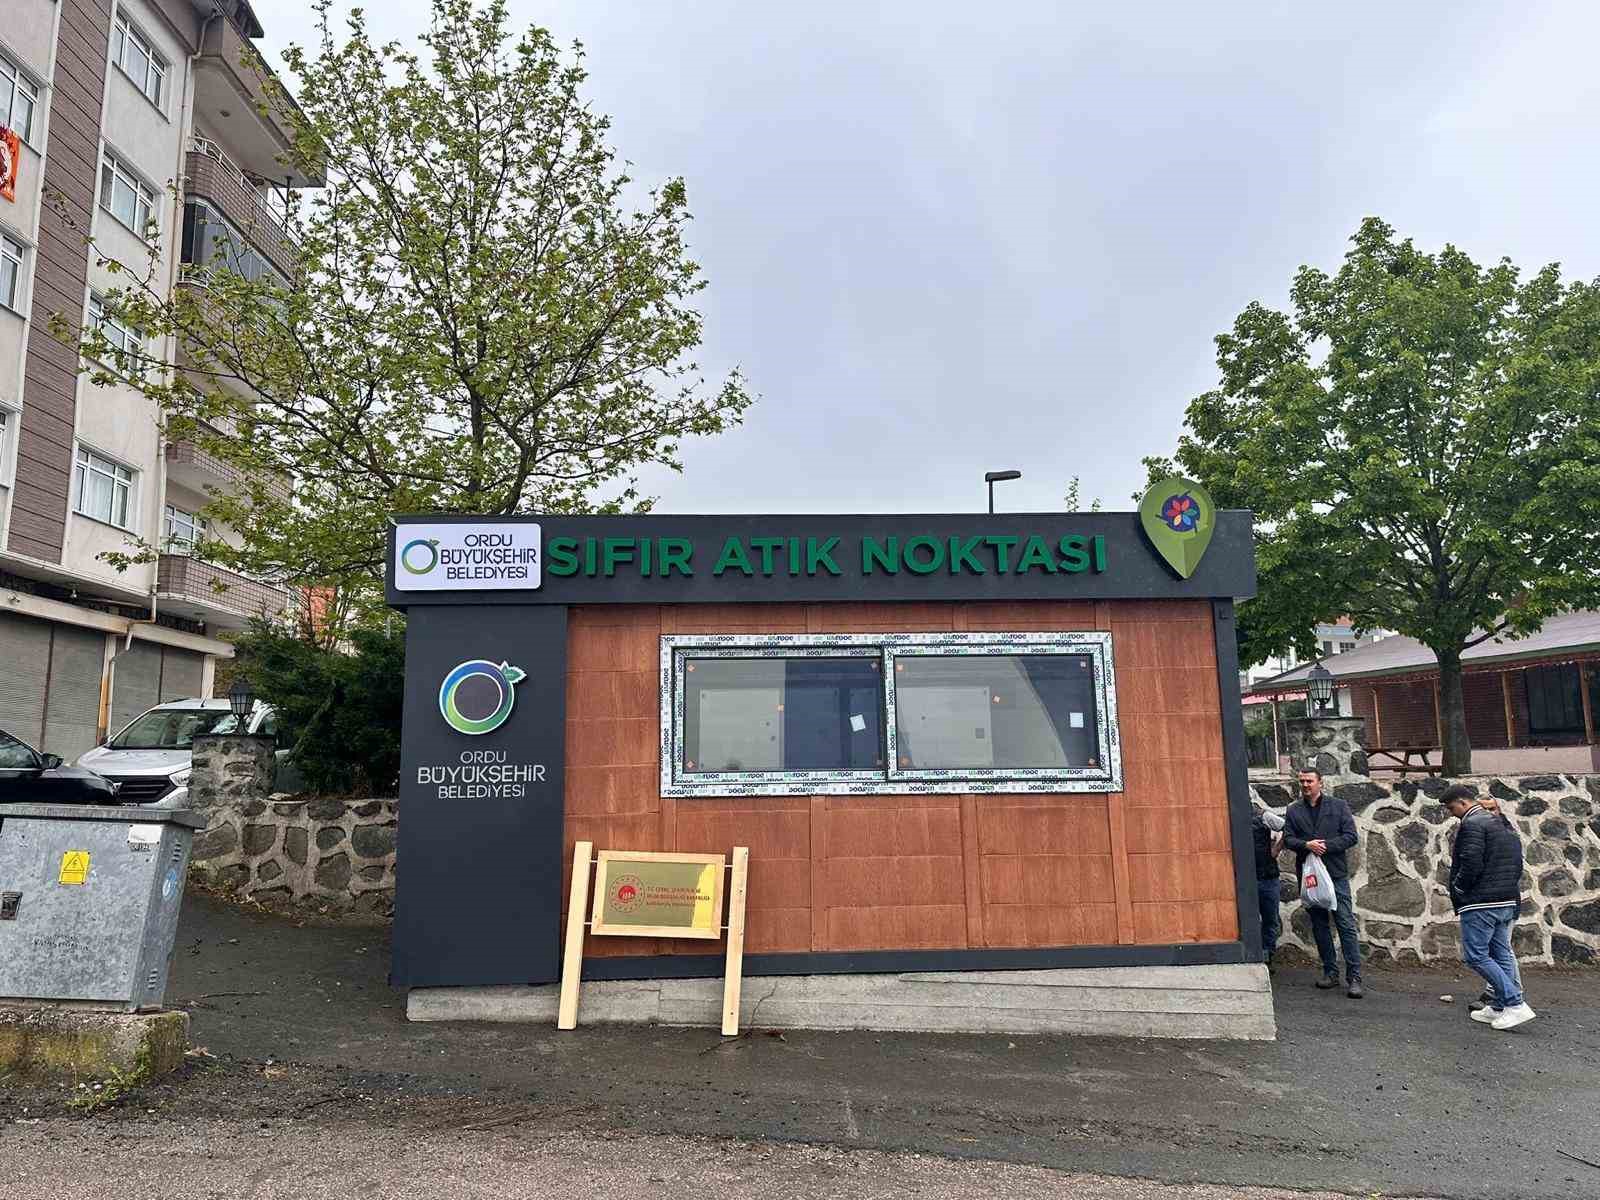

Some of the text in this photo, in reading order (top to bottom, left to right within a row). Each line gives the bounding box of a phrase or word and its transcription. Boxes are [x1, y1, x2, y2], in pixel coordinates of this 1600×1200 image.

[464, 533, 513, 547] ORDU
[440, 548, 537, 565] BÜYÜKŞEHİR
[546, 534, 1107, 577] SIFIR ATIK NOKTASI
[446, 566, 529, 580] BELEDİYESİ
[460, 750, 507, 764] ORDU
[417, 764, 546, 784] BÜYÜKŞEHİR
[438, 784, 526, 799] BELEDİYESİ
